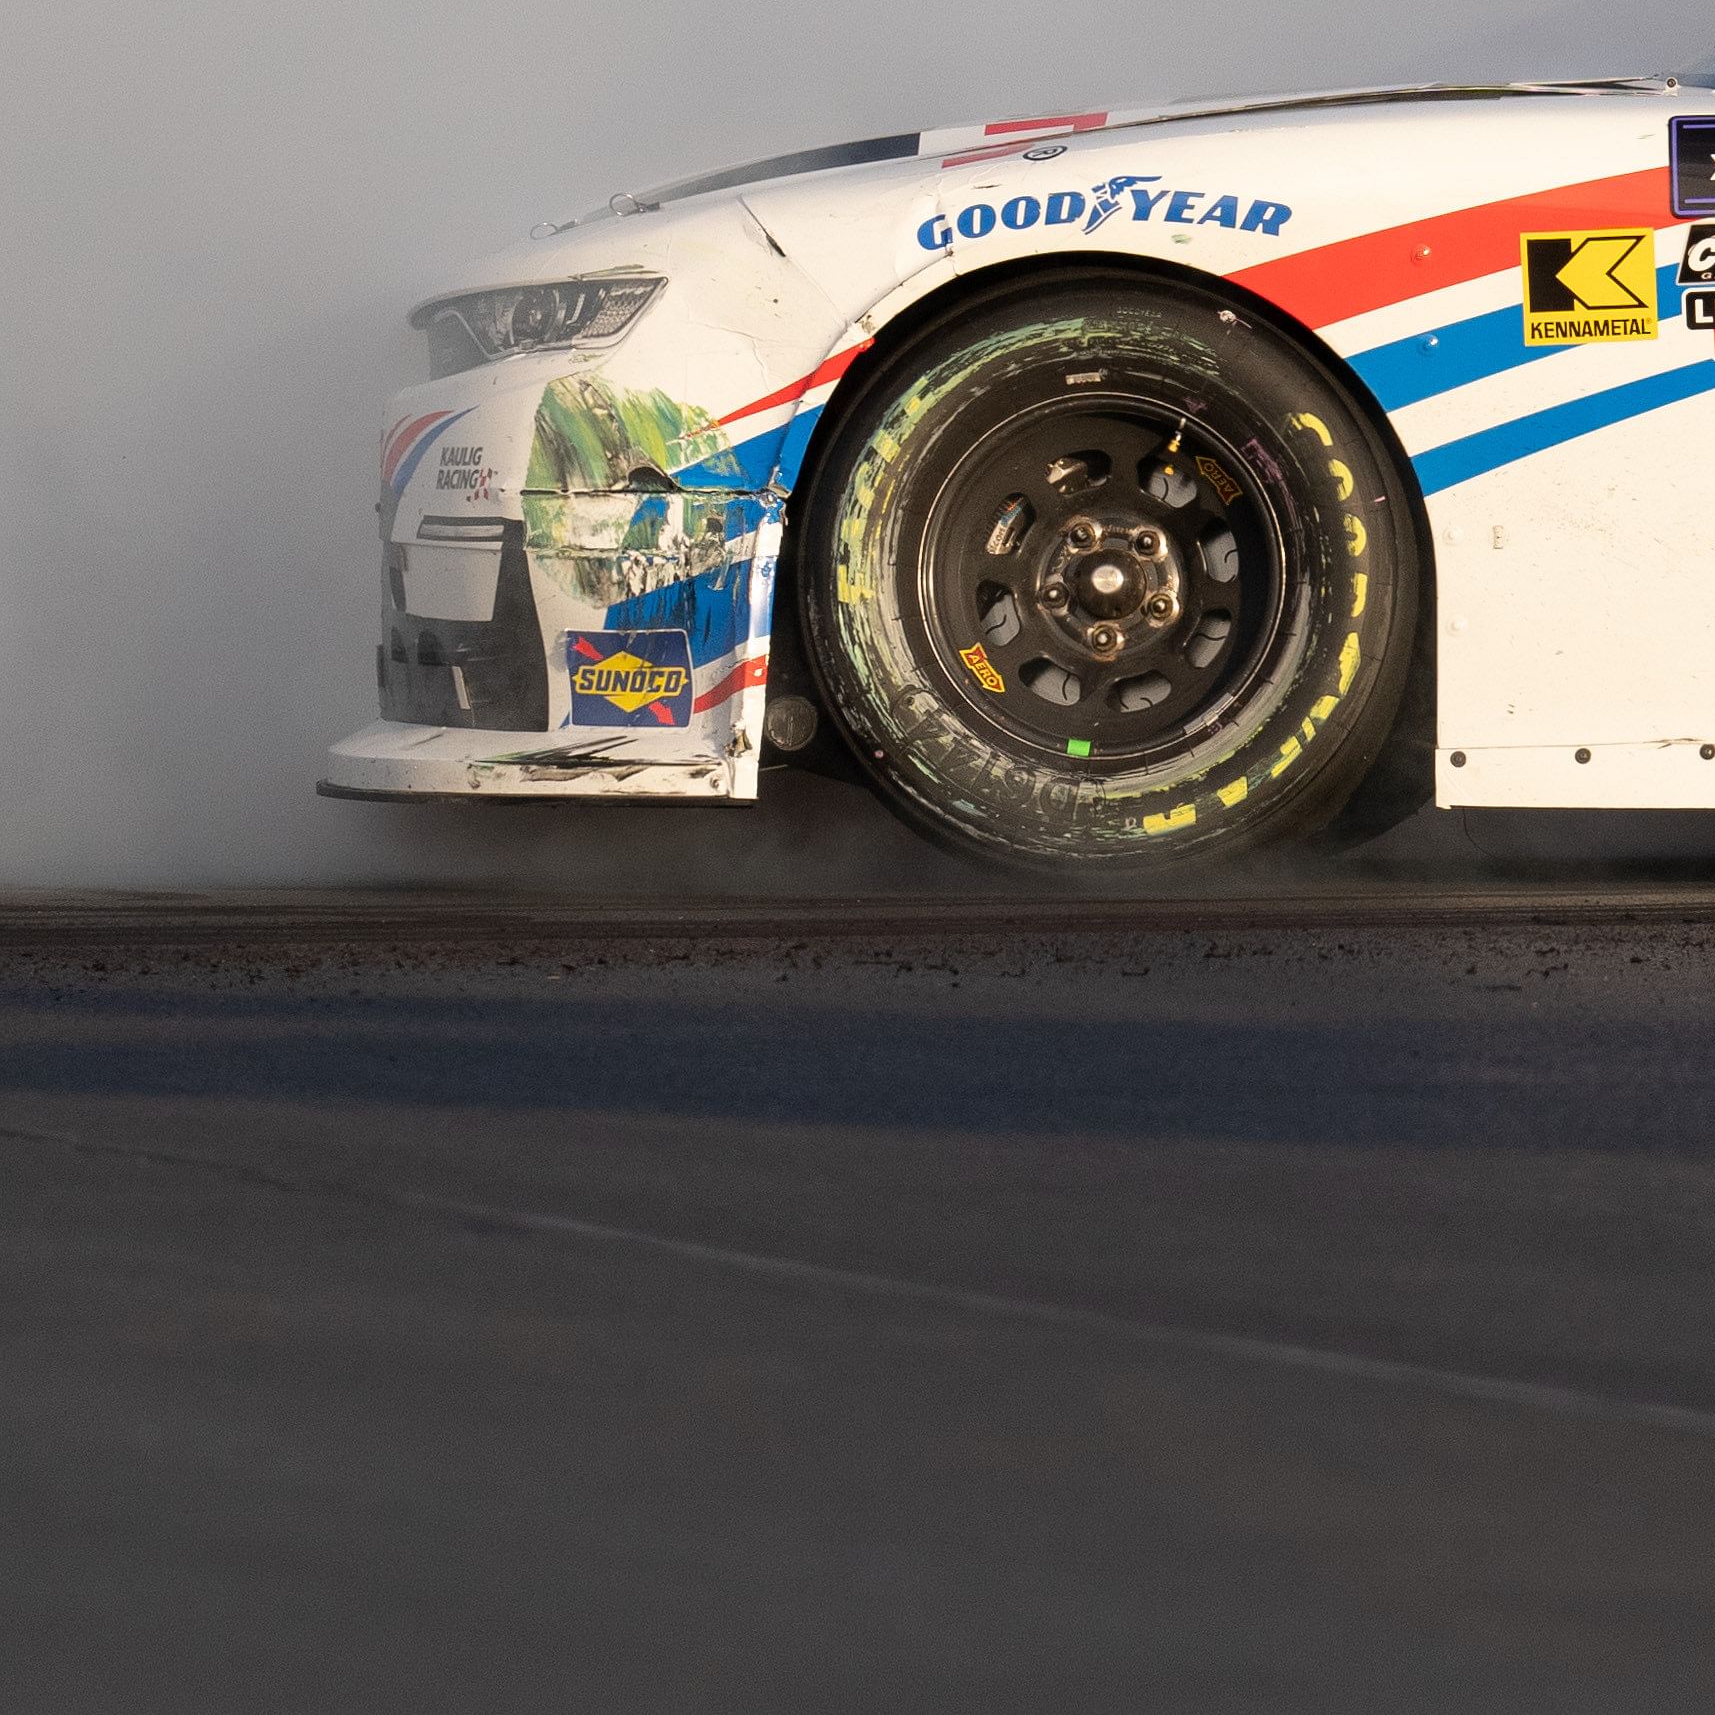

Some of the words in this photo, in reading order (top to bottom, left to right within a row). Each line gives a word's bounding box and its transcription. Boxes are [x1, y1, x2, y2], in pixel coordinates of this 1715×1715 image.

[917, 176, 1292, 251] GOODYEAR
[440, 446, 483, 466] KAULIG
[436, 469, 480, 490] RACING
[1203, 464, 1234, 493] AERO
[579, 668, 682, 694] SUNOCO
[969, 655, 998, 686] AERO
